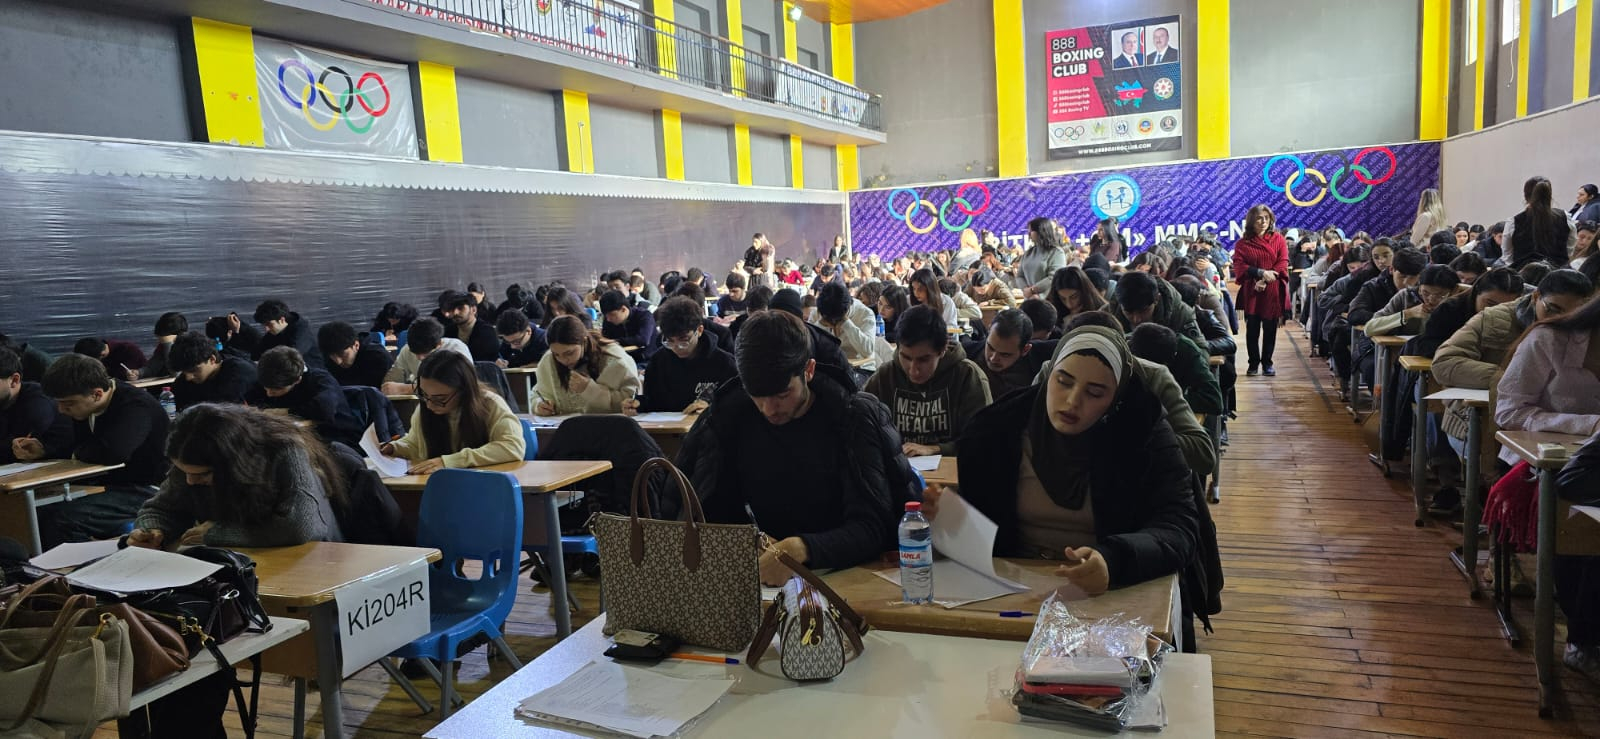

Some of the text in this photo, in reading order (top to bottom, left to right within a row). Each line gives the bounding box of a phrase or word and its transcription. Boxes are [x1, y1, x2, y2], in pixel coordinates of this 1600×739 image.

[1052, 37, 1075, 50] 888
[1053, 47, 1104, 64] BOXING
[1053, 63, 1087, 78] CLUB
[896, 397, 946, 417] MENTAL
[896, 414, 948, 434] HEALTH
[347, 580, 425, 636] Kİ204R
